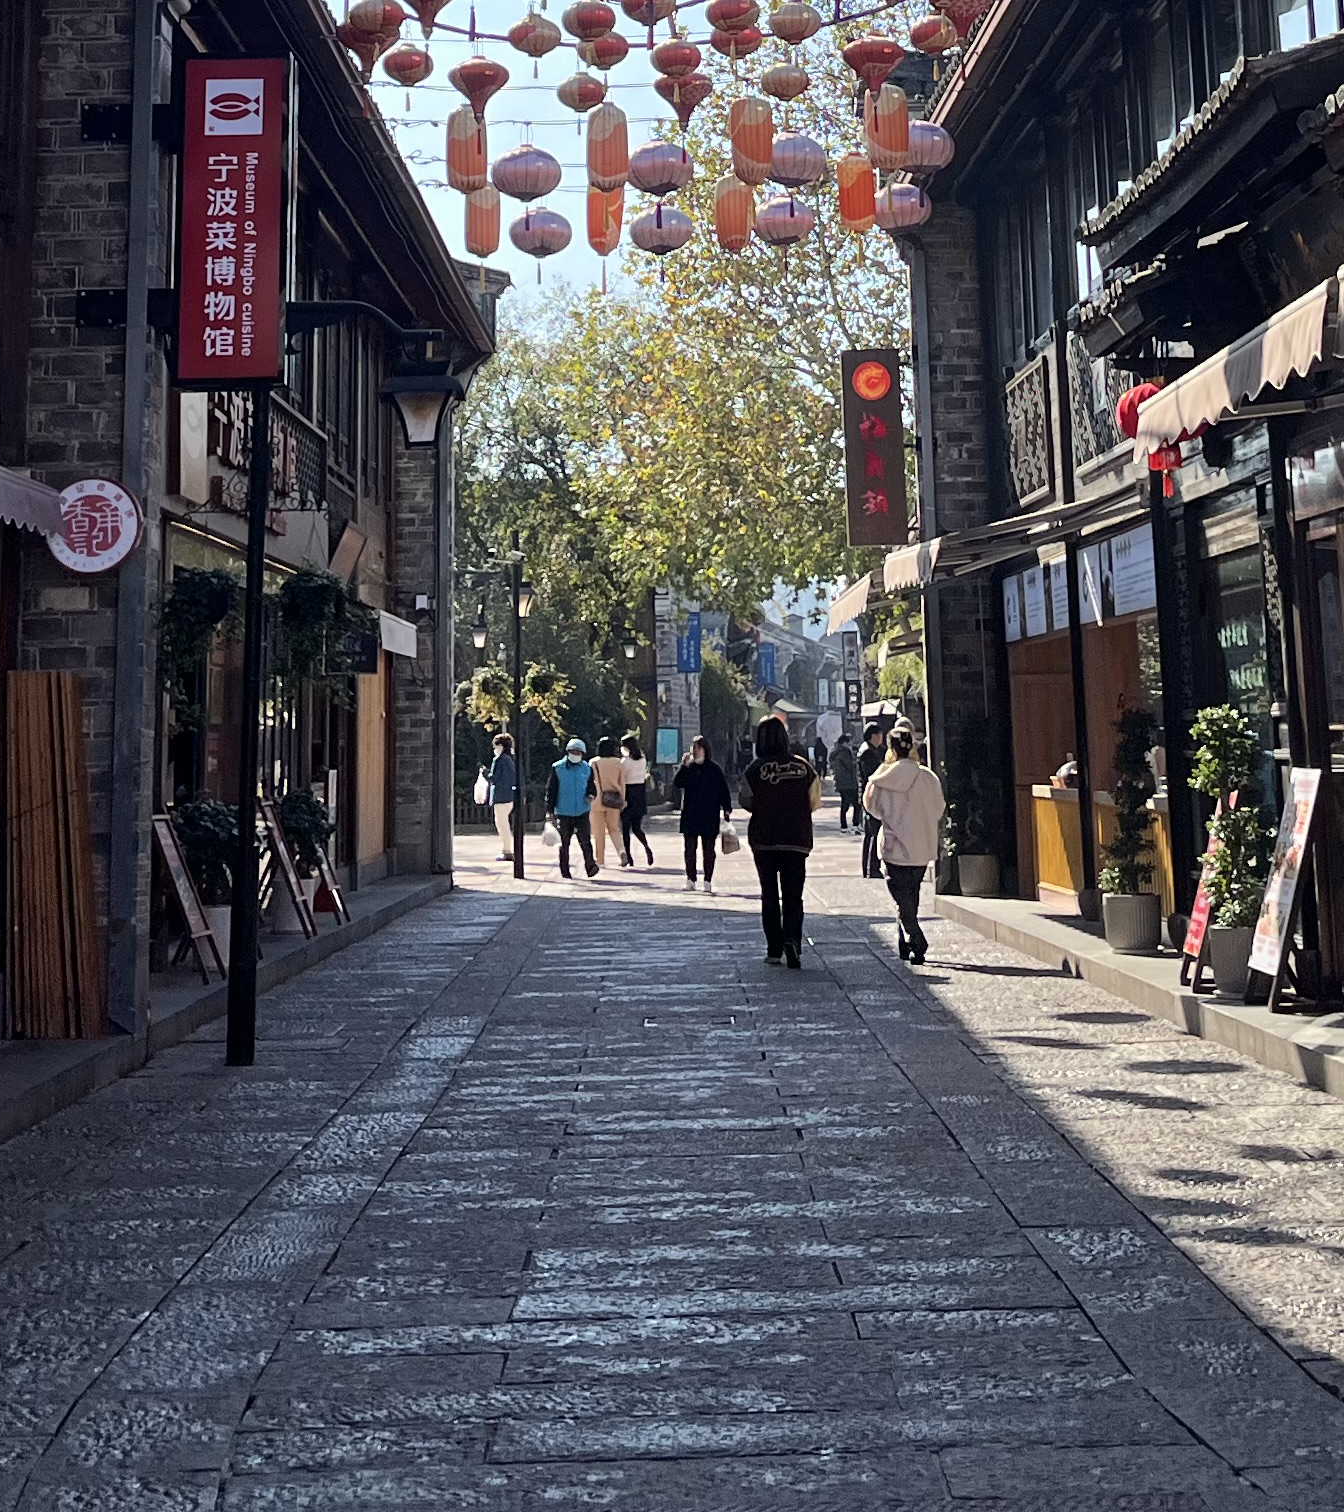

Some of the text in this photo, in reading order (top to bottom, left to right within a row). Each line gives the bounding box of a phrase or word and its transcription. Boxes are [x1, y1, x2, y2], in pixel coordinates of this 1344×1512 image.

[202, 153, 239, 358] 宁波菜博物馆
[240, 152, 259, 357] Museum of Ningbo cuisine
